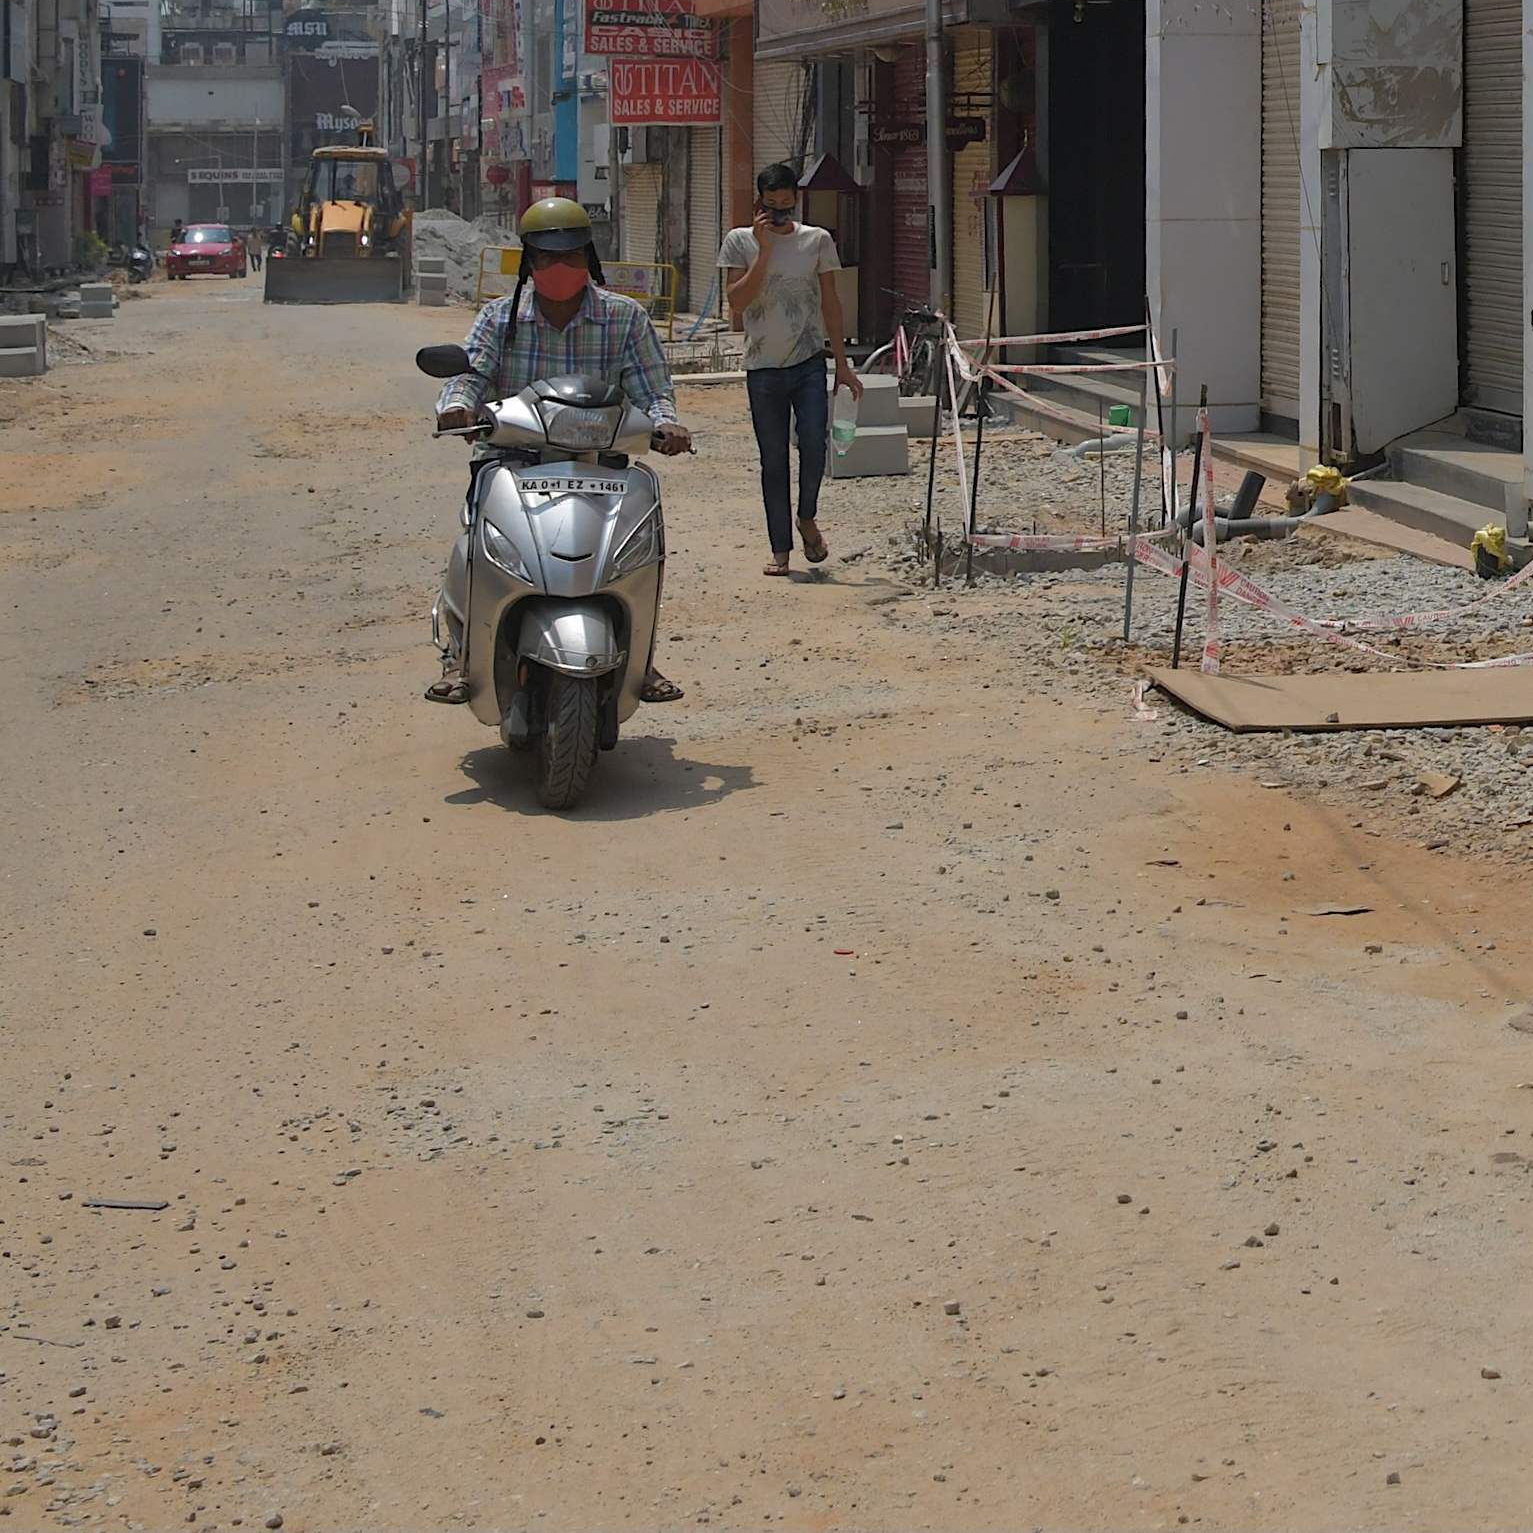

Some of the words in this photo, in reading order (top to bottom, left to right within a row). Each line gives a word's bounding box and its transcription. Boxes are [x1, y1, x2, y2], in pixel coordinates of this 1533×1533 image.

[286, 21, 328, 36] MSN
[591, 35, 633, 52] SALES
[638, 36, 649, 53] &
[653, 36, 712, 54] SERVICE
[635, 64, 719, 96] TITAN
[614, 98, 651, 115] SALES
[654, 98, 664, 115] &
[668, 98, 719, 115] SERVICE
[315, 112, 373, 133] Myso
[191, 170, 239, 181] SEQUINS
[522, 481, 538, 491] KA
[567, 480, 584, 490] EZ
[599, 482, 625, 493] 1461
[1239, 578, 1270, 603] CAUTION
